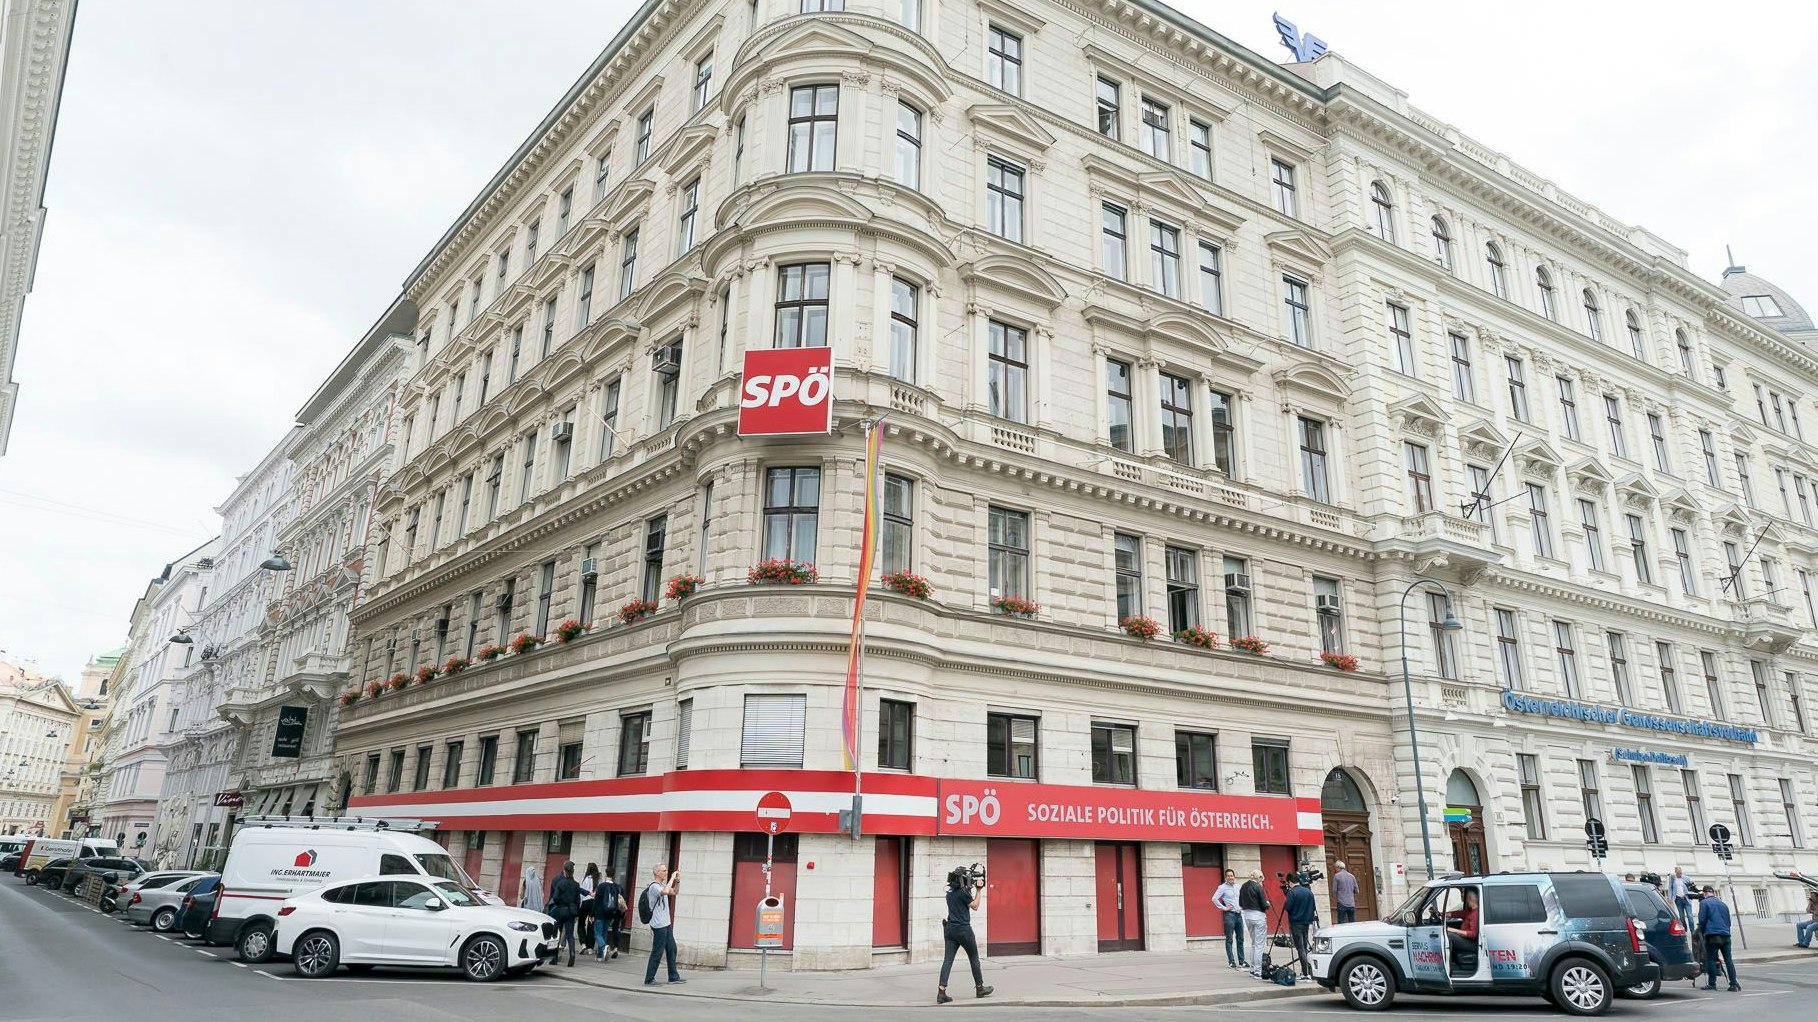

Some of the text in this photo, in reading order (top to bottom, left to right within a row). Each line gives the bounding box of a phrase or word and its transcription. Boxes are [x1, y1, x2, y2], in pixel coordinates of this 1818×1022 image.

[741, 366, 829, 408] SPÖ
[1503, 687, 1758, 743] Österreichischer Genossenschaftsverband
[945, 788, 1001, 826] SPÖ
[1027, 803, 1274, 830] SOZIALE POLITIK FÜR ÖSTERREICH.
[1489, 949, 1517, 962] TEN
